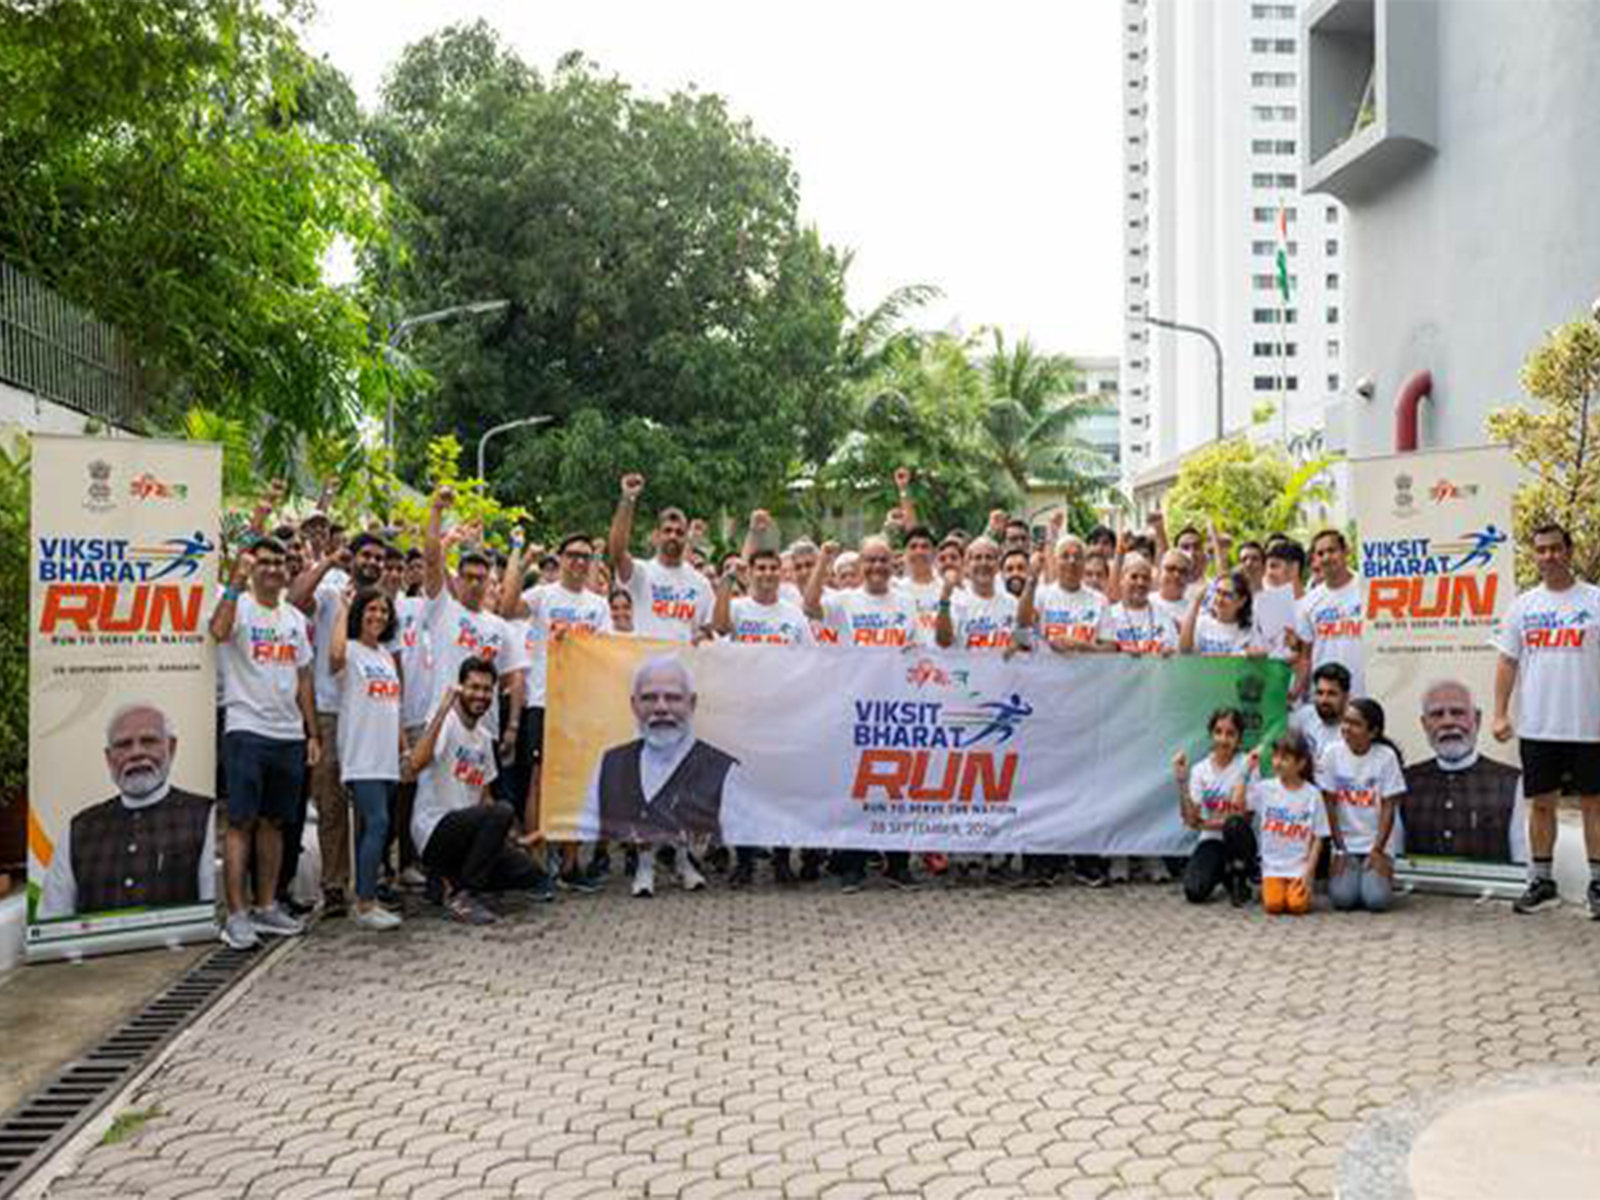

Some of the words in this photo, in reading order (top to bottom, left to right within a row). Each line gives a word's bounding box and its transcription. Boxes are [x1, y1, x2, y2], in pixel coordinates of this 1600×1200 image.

[39, 539, 128, 560] VIKSIT
[1363, 539, 1431, 559] VIKSIT
[39, 561, 152, 582] BHARAT
[1363, 556, 1451, 578] BHARAT
[1367, 574, 1498, 619] RUN
[39, 585, 204, 633] RUN
[652, 600, 695, 619] RUN
[51, 635, 77, 645] RUN
[161, 634, 204, 644] NATION
[854, 629, 906, 646] RUN
[1317, 623, 1362, 636] RUN
[1525, 629, 1583, 647] RUN
[855, 700, 942, 725] VIKSIT
[854, 725, 965, 748] BHARAT
[852, 750, 1017, 802] RUN
[863, 803, 887, 813] RUN
[1263, 819, 1311, 838] RUN
